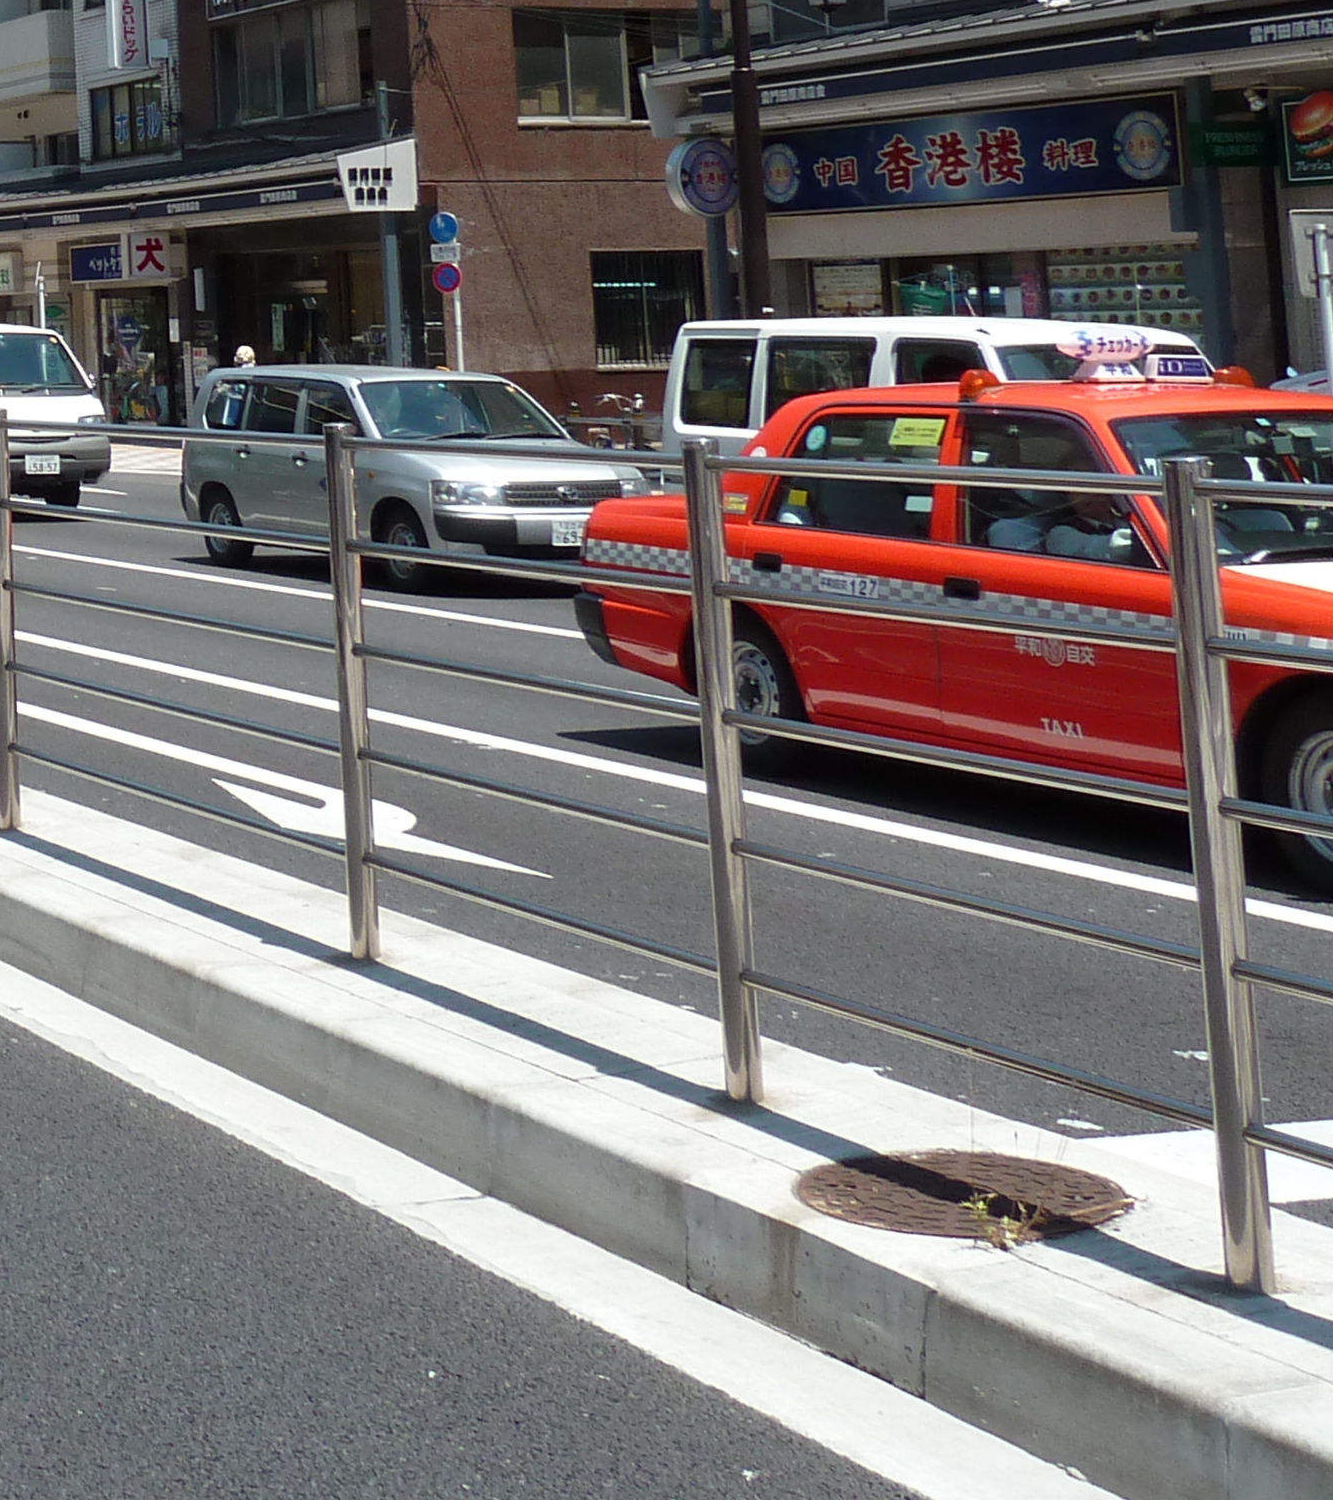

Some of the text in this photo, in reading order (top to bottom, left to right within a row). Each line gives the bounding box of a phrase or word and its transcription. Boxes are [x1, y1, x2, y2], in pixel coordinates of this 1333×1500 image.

[813, 126, 1100, 195] 中国 香港楼 料理
[1295, 160, 1333, 171] フレッシュ
[135, 238, 165, 273] 犬
[849, 580, 877, 597] 127
[1040, 717, 1083, 739] TAXI
